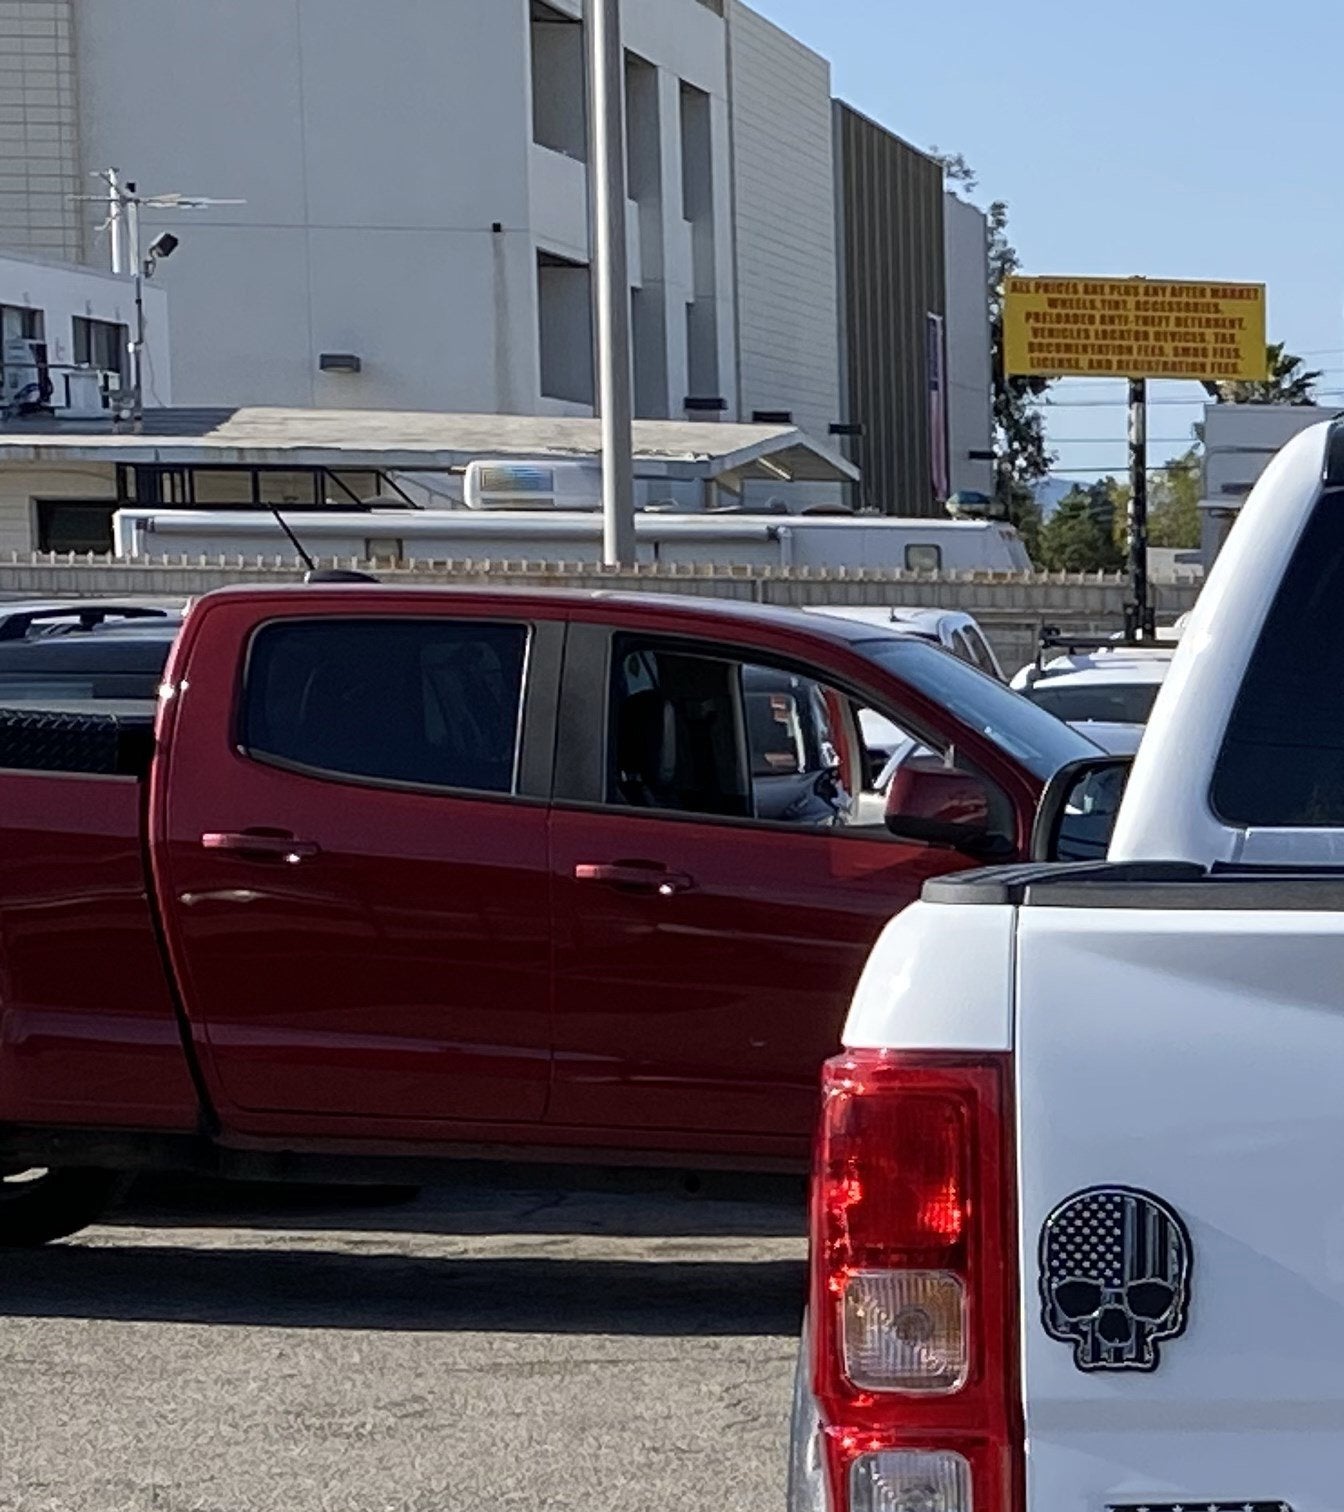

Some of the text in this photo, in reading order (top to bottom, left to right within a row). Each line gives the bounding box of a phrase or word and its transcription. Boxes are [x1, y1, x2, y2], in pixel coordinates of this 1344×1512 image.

[1011, 281, 1259, 300] ALL PRICES ARE PLUS ANY AFTER MARKET
[1094, 329, 1149, 342] LOCATOR
[1028, 342, 1133, 356] DOCUMENTATION
[1173, 346, 1208, 359] SMOG
[1088, 358, 1113, 371] AND
[1117, 360, 1206, 374] REGISTRATION
